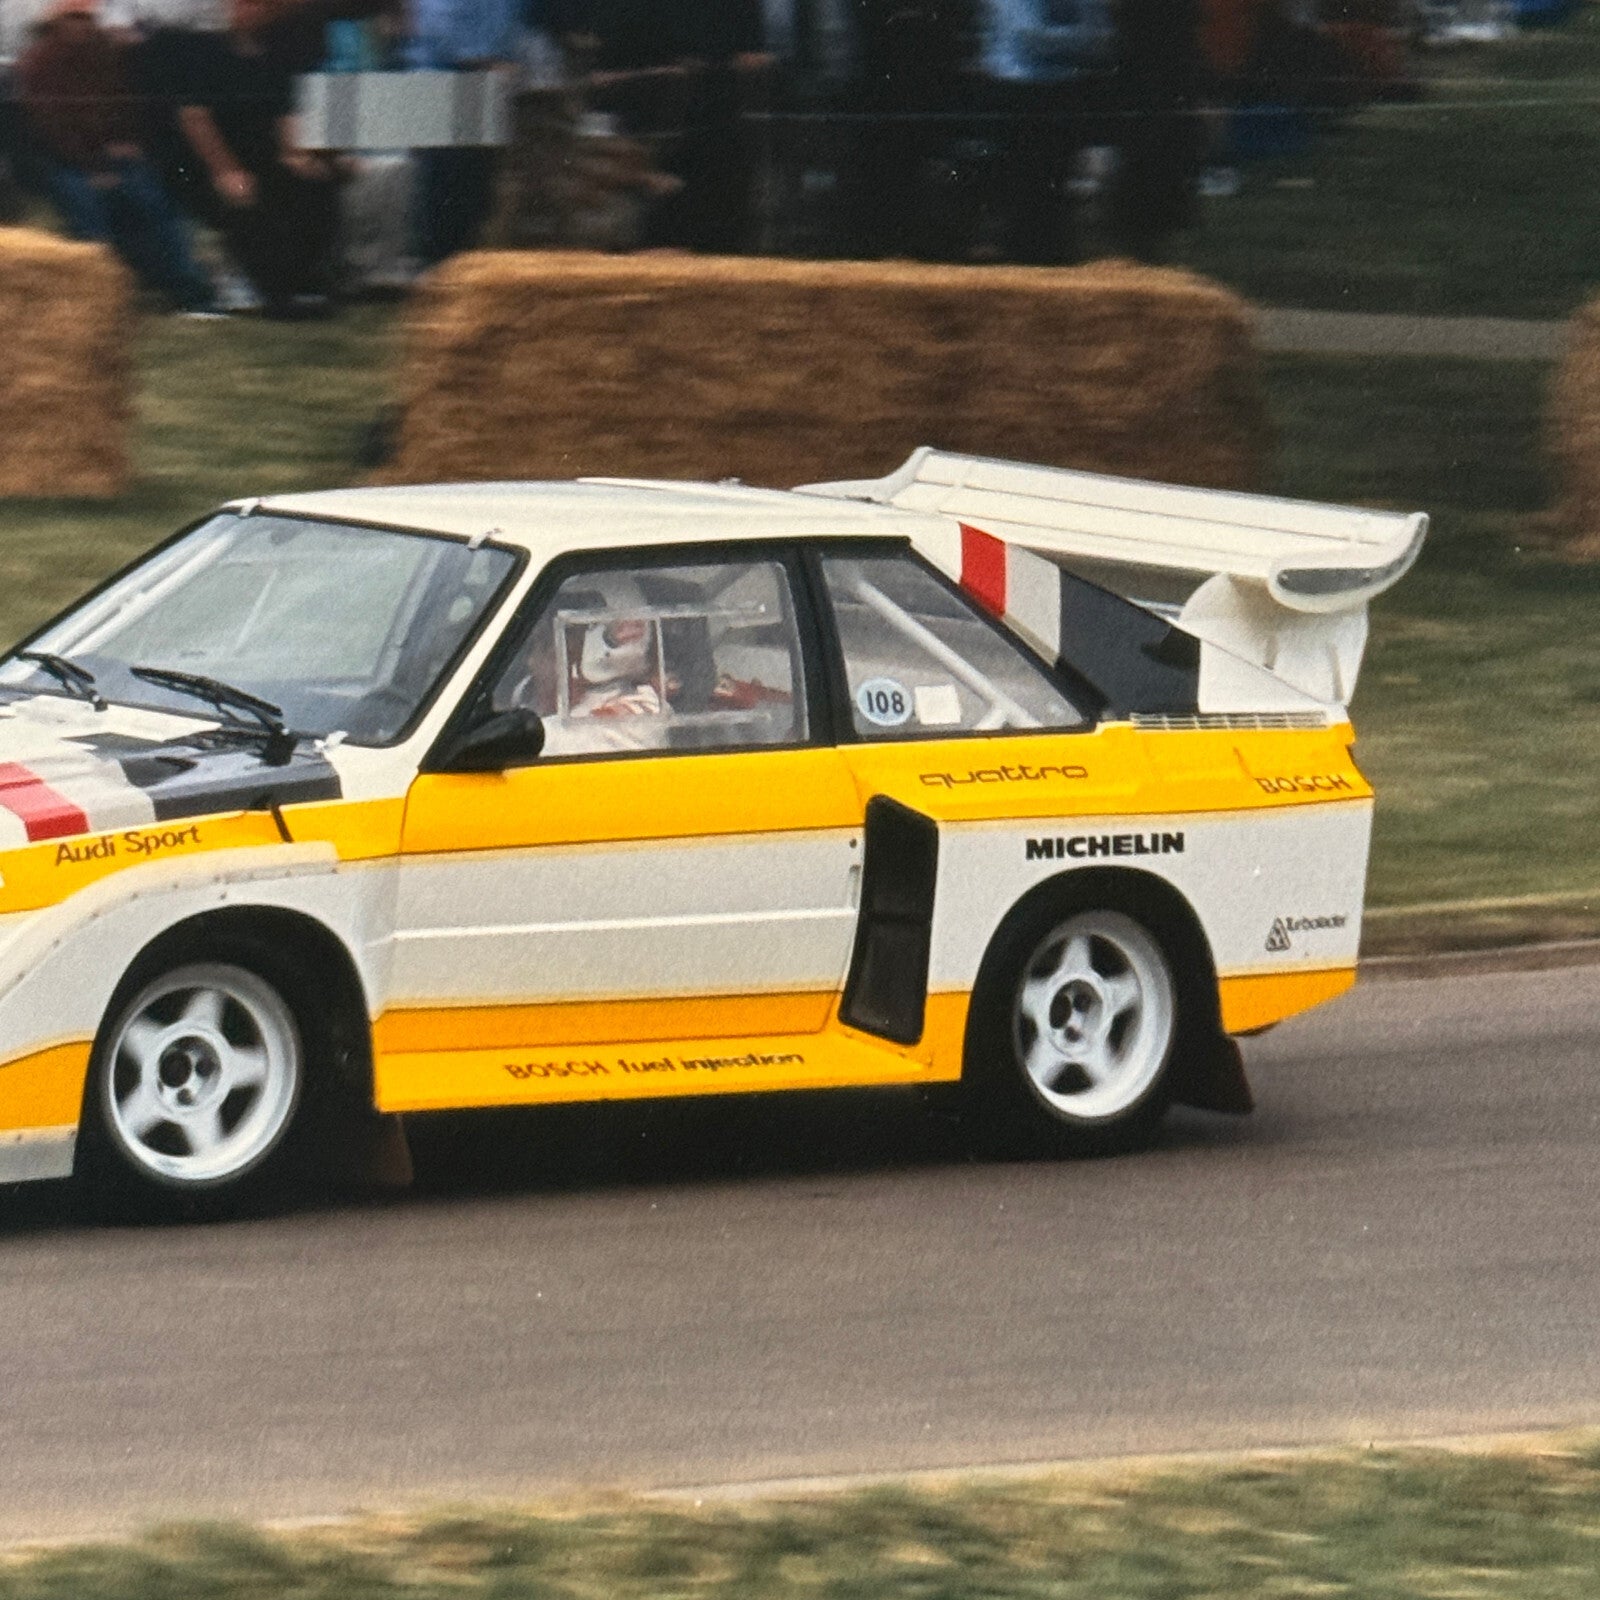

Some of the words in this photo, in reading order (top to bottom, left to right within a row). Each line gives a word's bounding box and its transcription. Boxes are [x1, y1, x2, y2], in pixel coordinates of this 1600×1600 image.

[866, 690, 905, 714] 108
[919, 765, 1088, 788] quattro
[1254, 774, 1353, 793] BOSCH
[56, 836, 116, 866] Audi
[124, 825, 202, 855] Sport
[1025, 832, 1185, 860] MICHELIN
[504, 1059, 611, 1080] BOSCH
[617, 1056, 677, 1075] fuel
